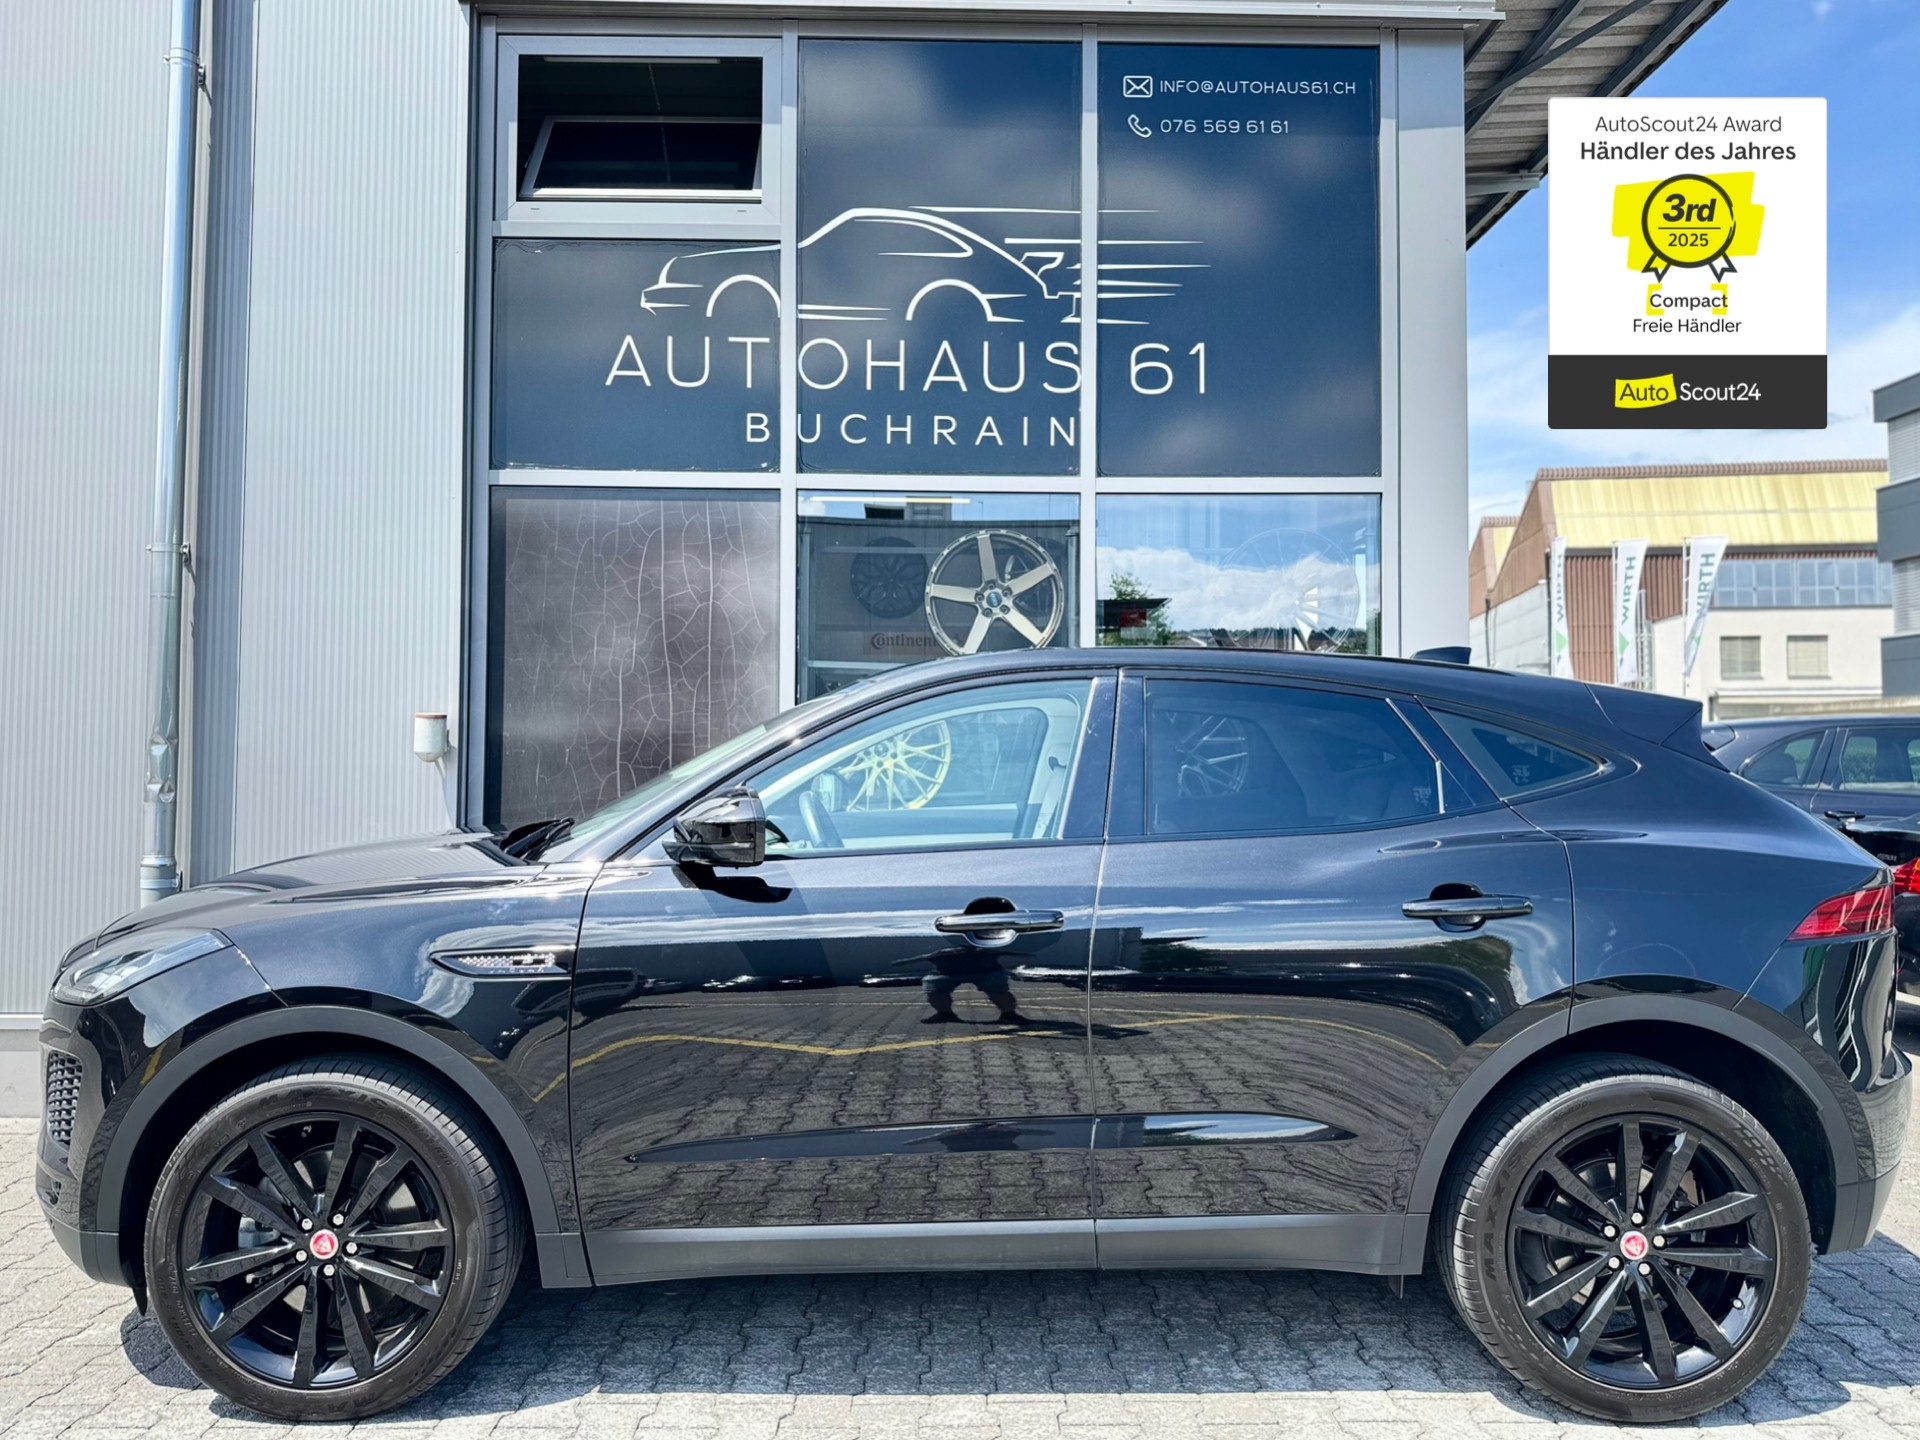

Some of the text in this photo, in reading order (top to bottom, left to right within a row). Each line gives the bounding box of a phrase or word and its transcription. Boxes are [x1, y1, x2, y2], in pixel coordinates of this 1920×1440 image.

[1160, 80, 1356, 95] INFO@AUTOHAUS61.CH
[1160, 119, 1289, 134] 076 569 61 61
[605, 334, 1206, 396] AUTOHAUS 61
[745, 412, 1076, 447] BUCHRAIN
[1621, 556, 1636, 625] WIRTH
[871, 632, 938, 650] Continen
